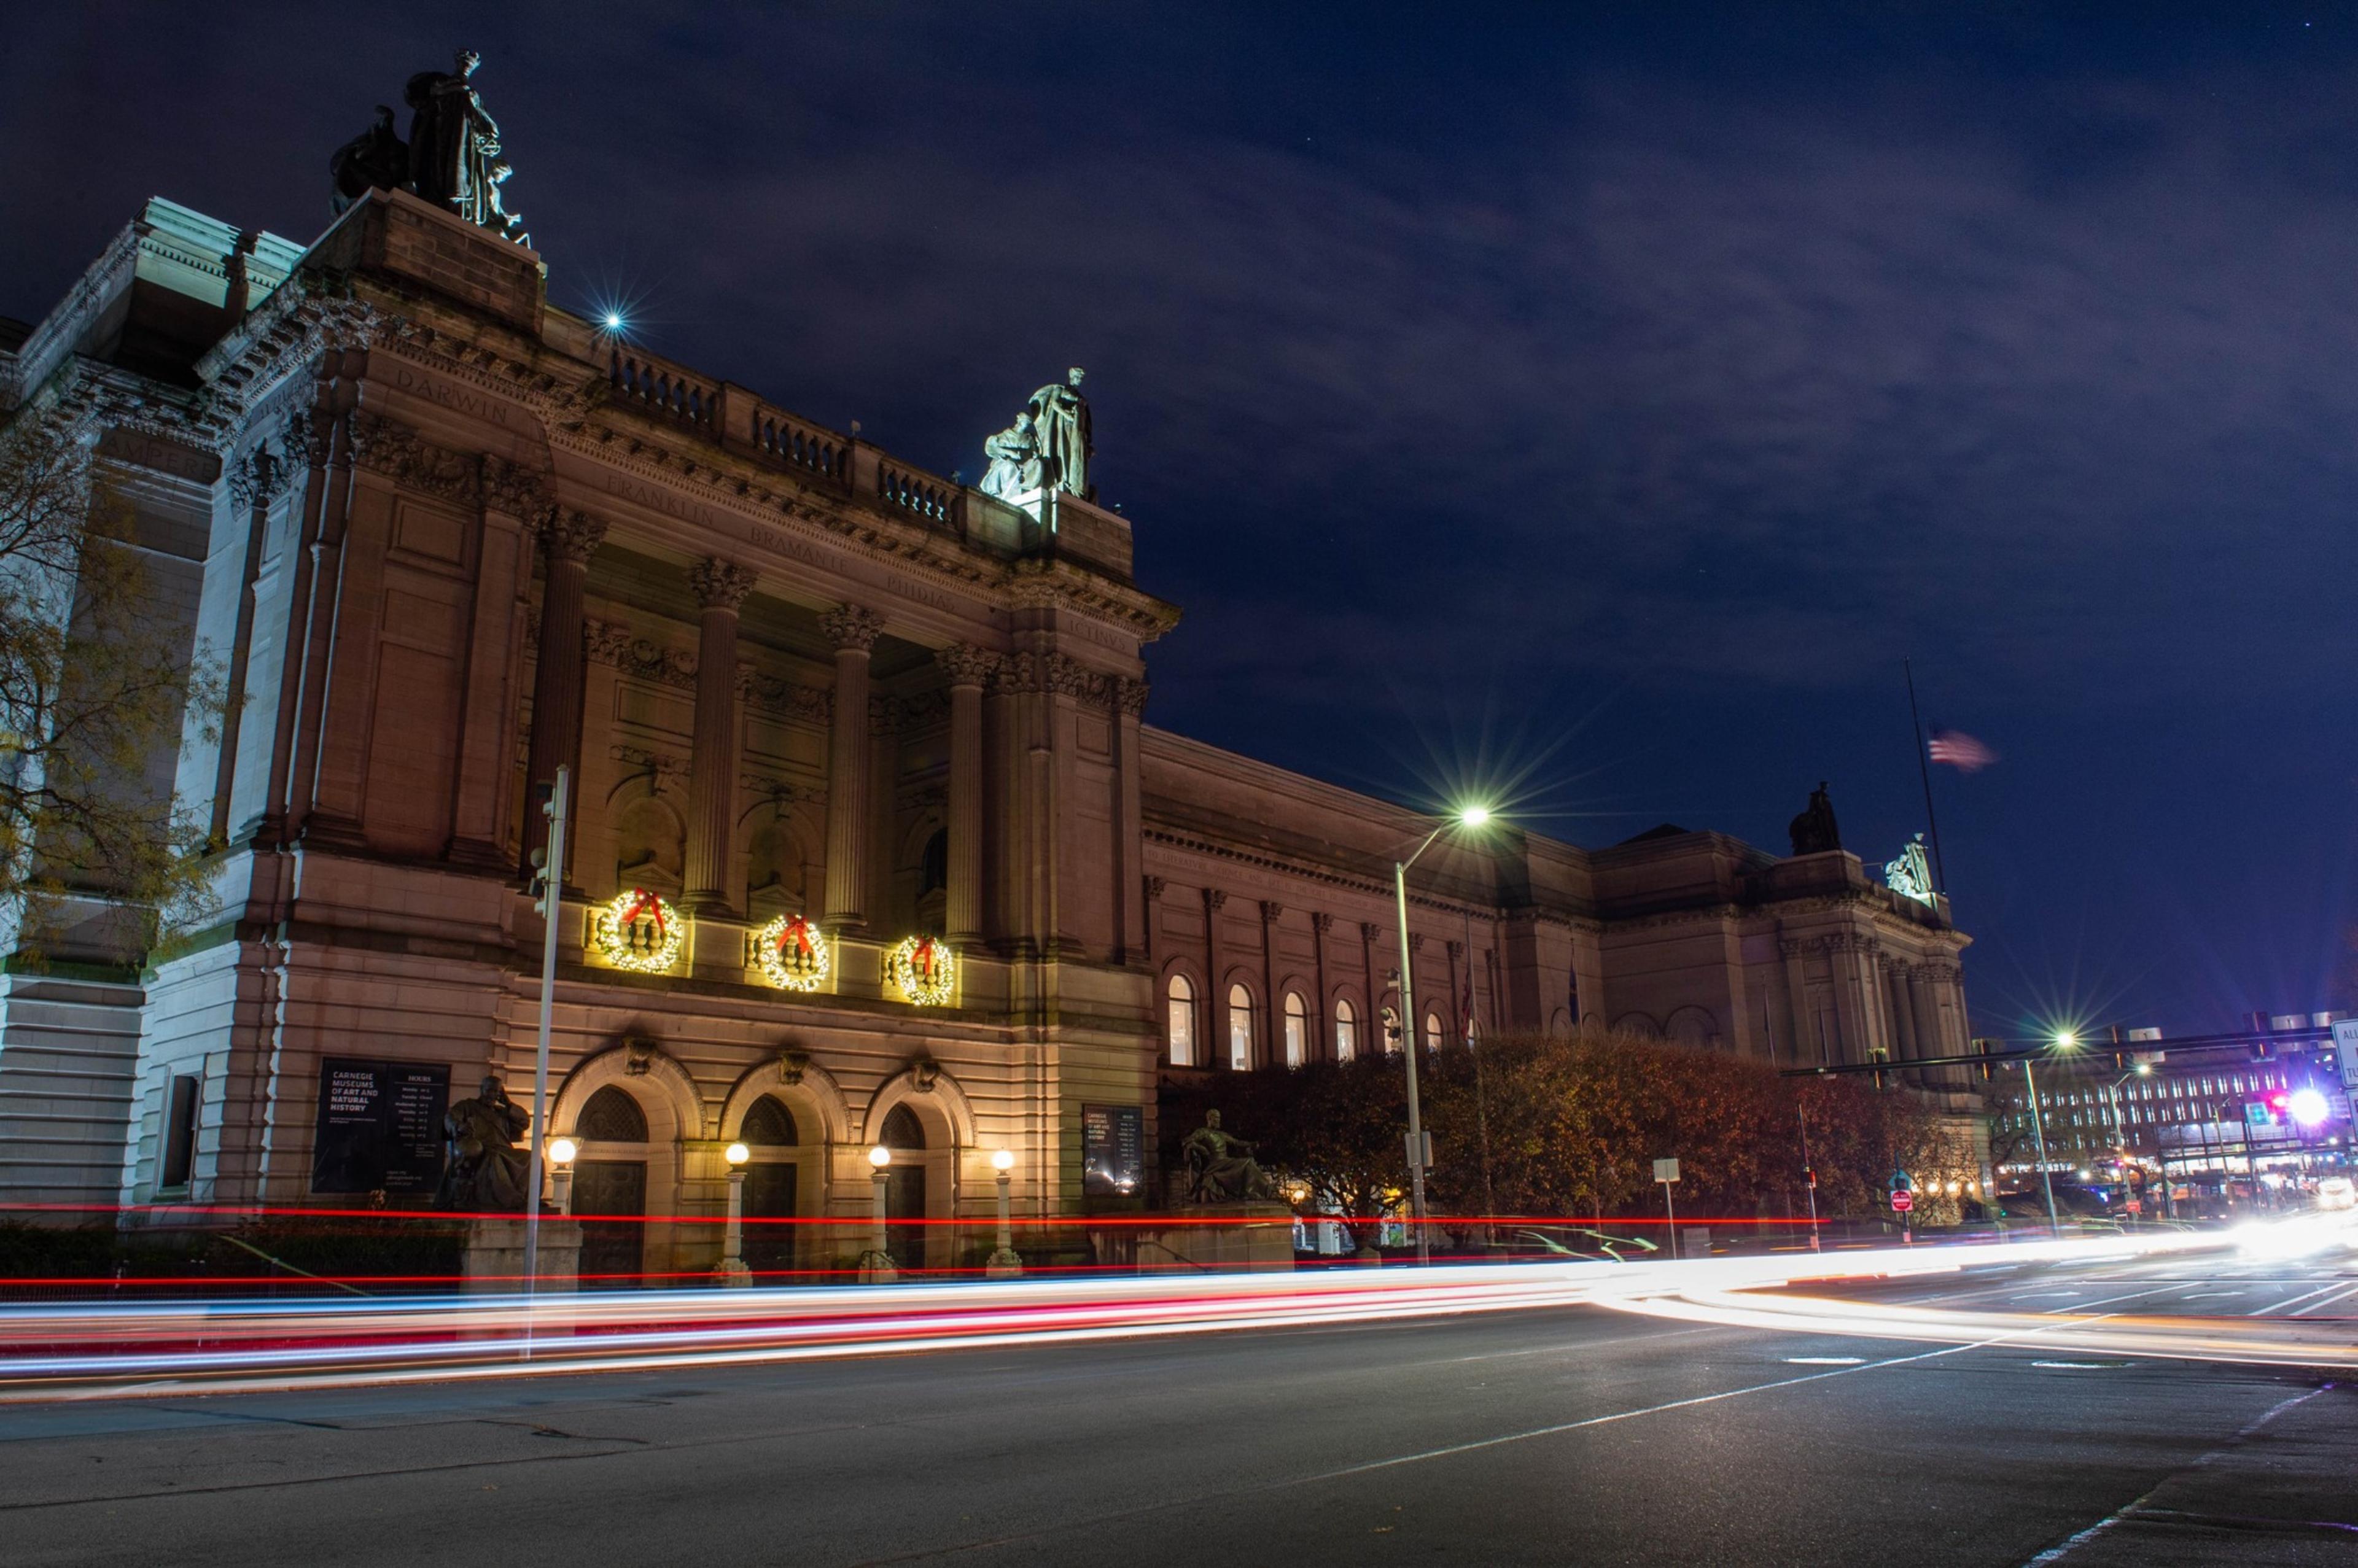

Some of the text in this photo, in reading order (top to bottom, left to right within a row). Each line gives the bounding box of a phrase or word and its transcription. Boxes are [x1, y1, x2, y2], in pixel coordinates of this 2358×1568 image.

[396, 368, 508, 424] DARWIN
[106, 435, 214, 481] AMPERE
[606, 475, 714, 526] FRANKLIN
[750, 525, 850, 575] BRAMANTE
[1069, 619, 1126, 651] ICTINVS
[333, 1071, 373, 1080] CARNEGIE
